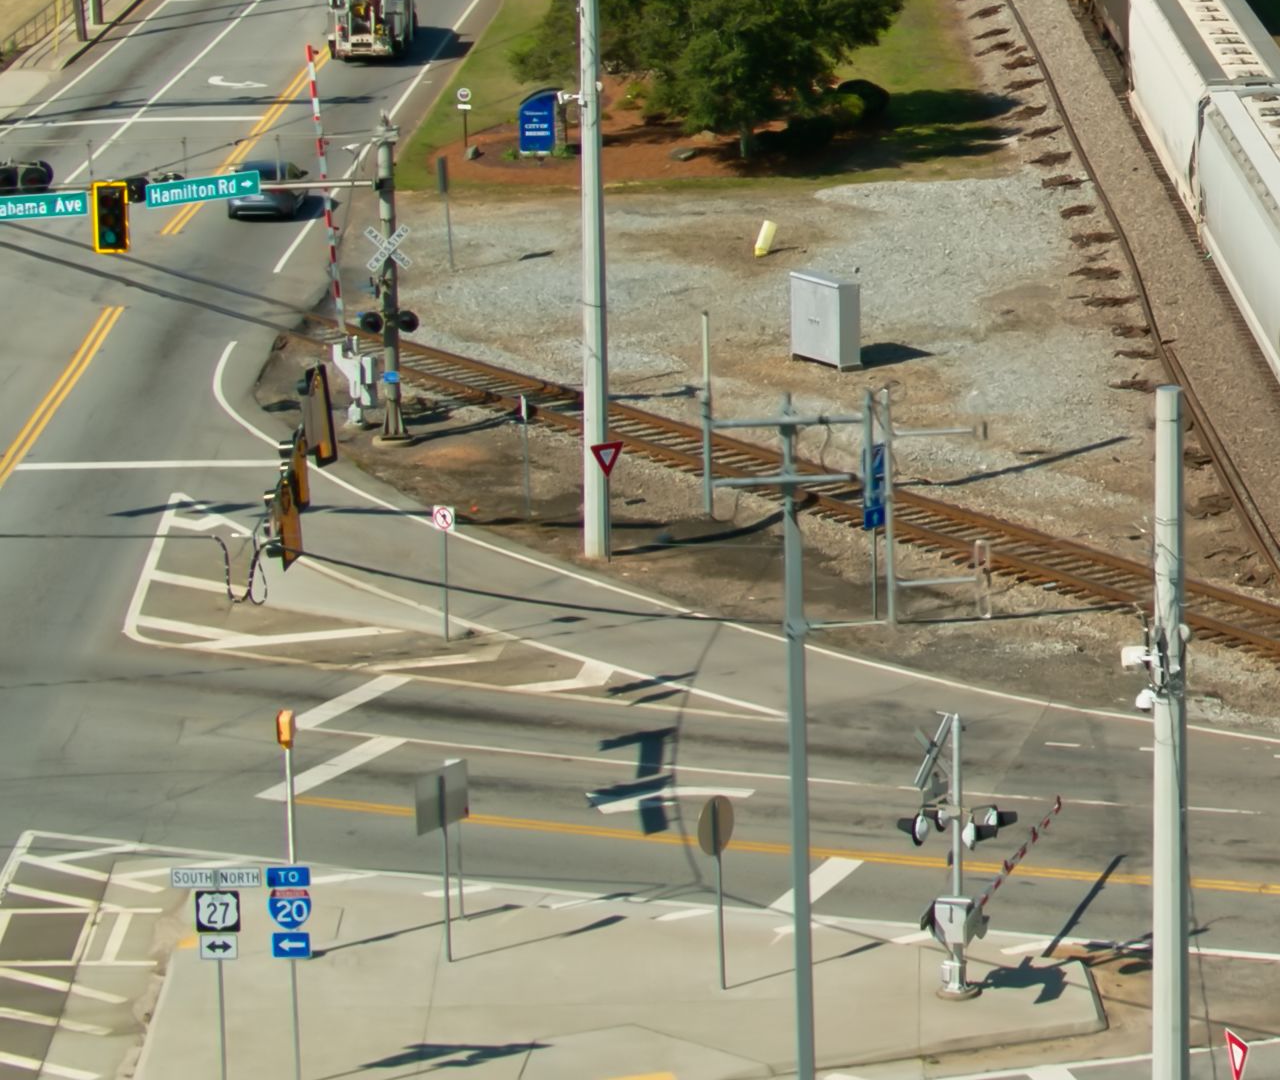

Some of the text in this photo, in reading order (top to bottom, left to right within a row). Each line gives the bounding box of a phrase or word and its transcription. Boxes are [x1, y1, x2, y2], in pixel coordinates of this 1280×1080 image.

[151, 178, 236, 204] Hamilton Rd
[55, 197, 82, 213] Ave
[174, 871, 213, 884] SOUTH
[220, 871, 259, 884] NORTH
[278, 871, 299, 883] TO
[206, 902, 230, 924] 27
[276, 900, 308, 923] 20
